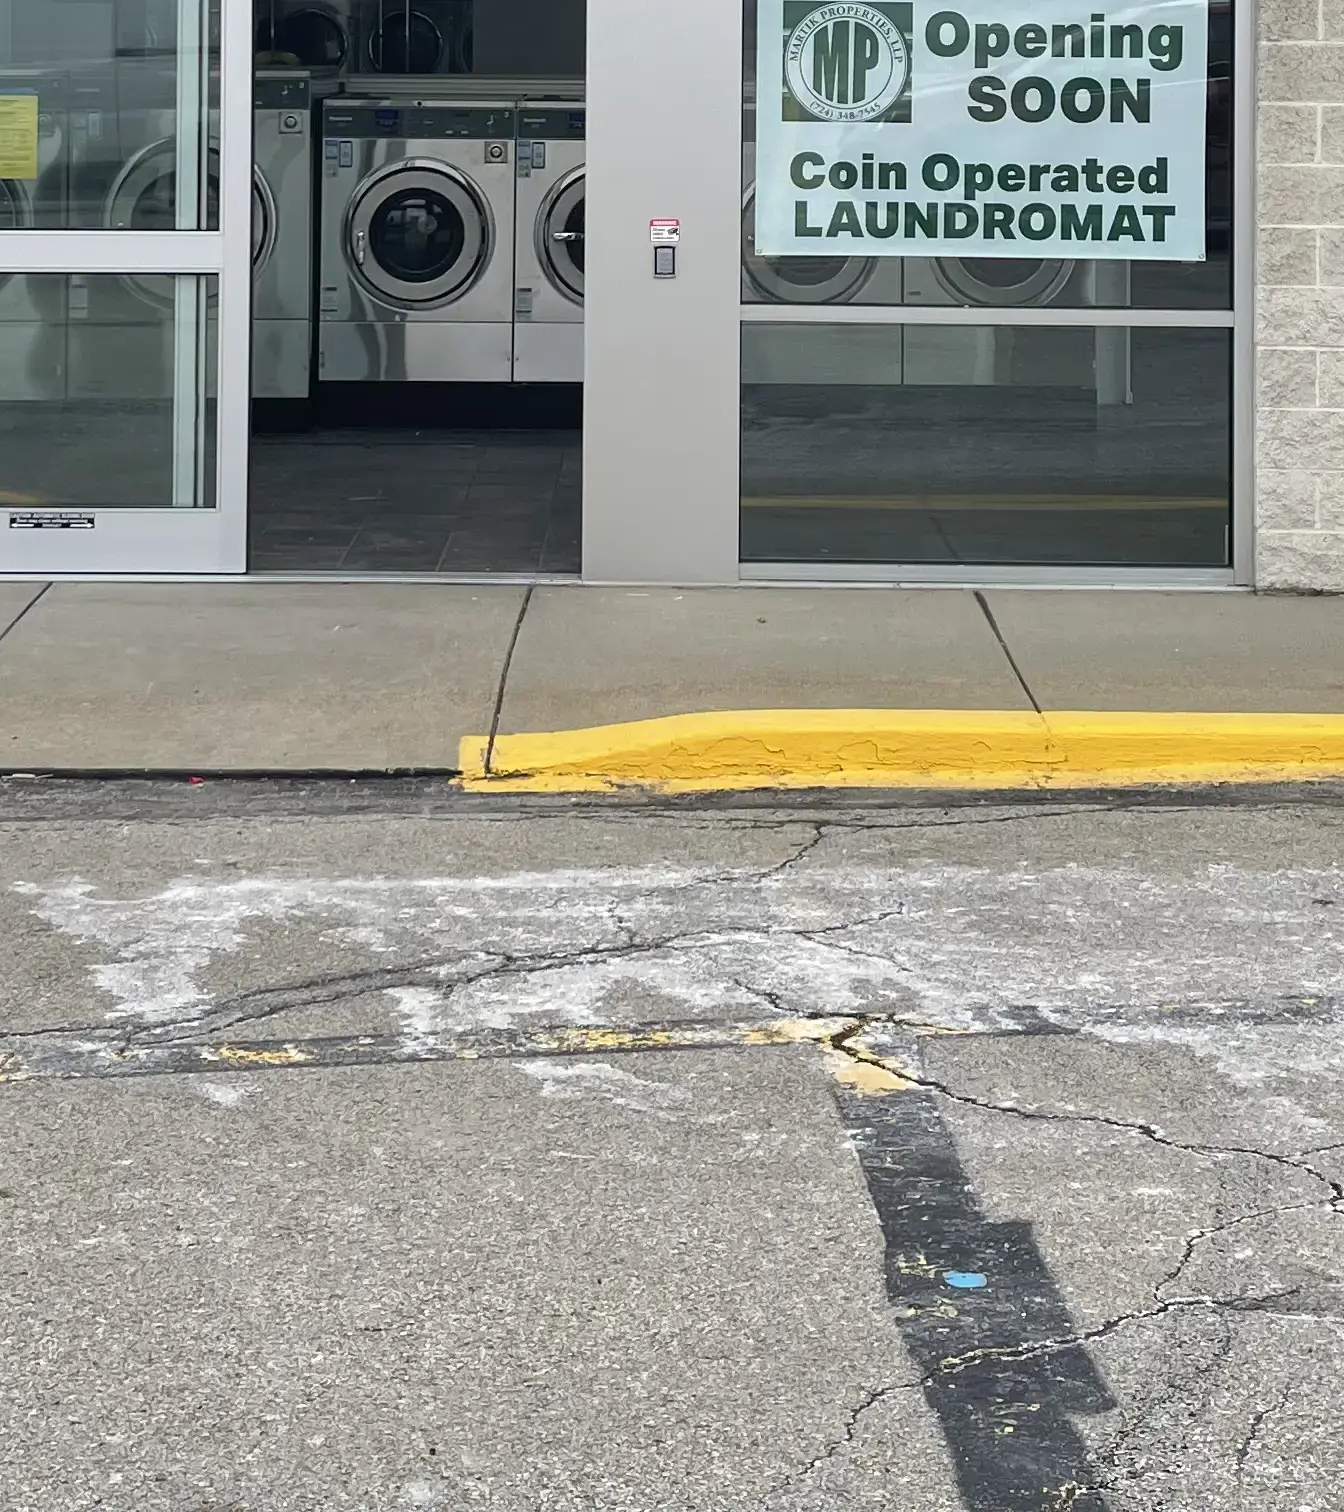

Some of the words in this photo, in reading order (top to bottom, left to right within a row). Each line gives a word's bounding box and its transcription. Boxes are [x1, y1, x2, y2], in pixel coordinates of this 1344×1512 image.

[790, 16, 818, 61] MARTIK
[891, 40, 903, 63] LLP
[812, 19, 880, 105] MP
[925, 10, 1184, 71] Opening
[967, 75, 1151, 124] SOON
[790, 151, 907, 190] Coin
[921, 153, 1168, 200] Operated
[794, 200, 1176, 242] LAUNDROMAT
